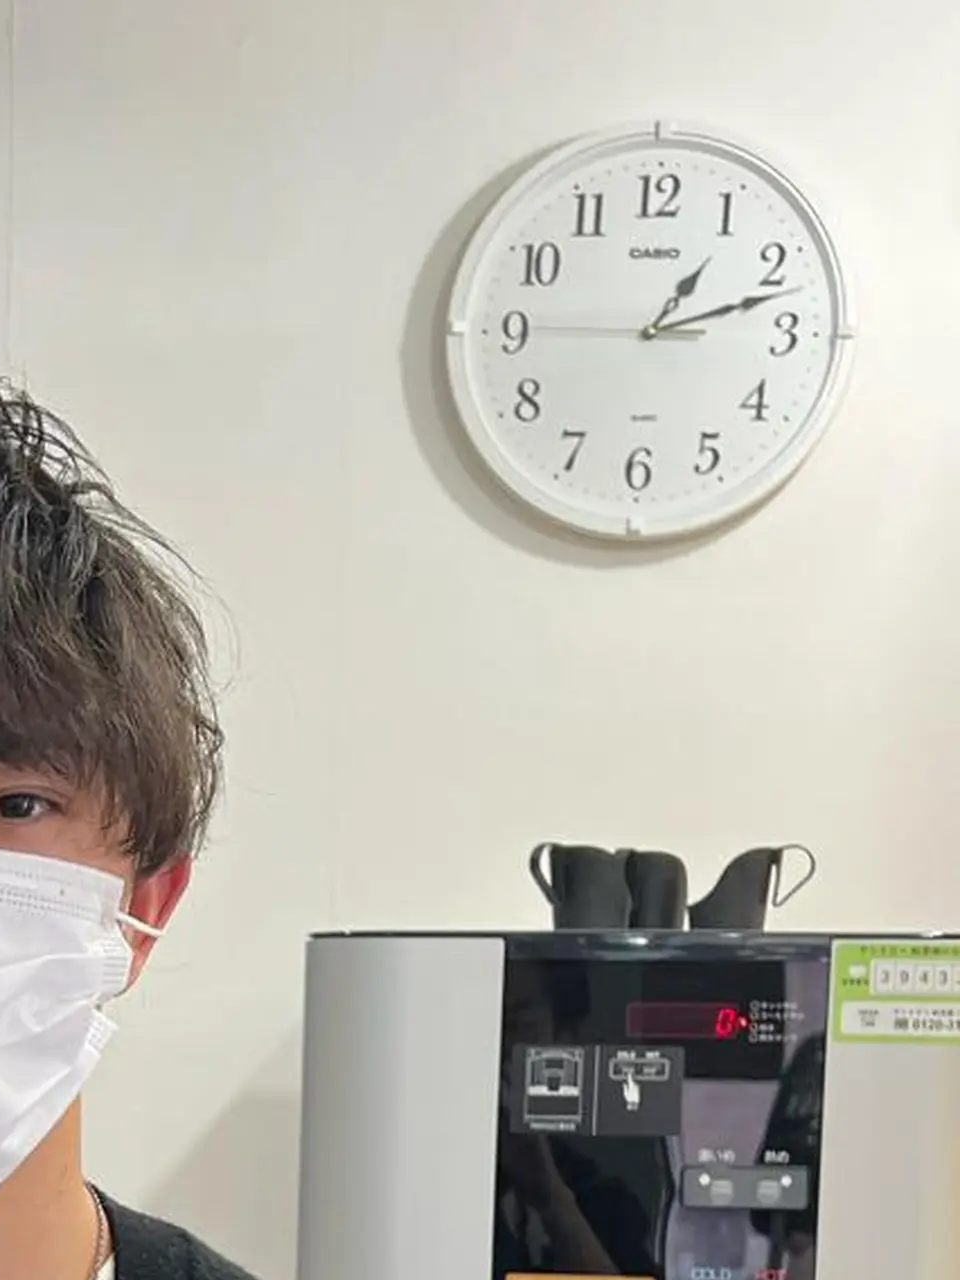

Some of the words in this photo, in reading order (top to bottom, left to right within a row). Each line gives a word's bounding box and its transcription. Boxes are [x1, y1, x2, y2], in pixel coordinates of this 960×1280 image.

[572, 193, 606, 237] 11
[636, 174, 681, 219] 12
[716, 192, 735, 237] 1
[520, 243, 560, 286] 10
[759, 243, 787, 286] 2
[501, 311, 528, 354] 9
[769, 312, 798, 356] 3
[514, 379, 541, 421] 8
[739, 379, 769, 421] 4
[561, 431, 587, 471] 7
[625, 448, 652, 490] 6
[694, 433, 721, 474] 5
[691, 1268, 731, 1280] COLD
